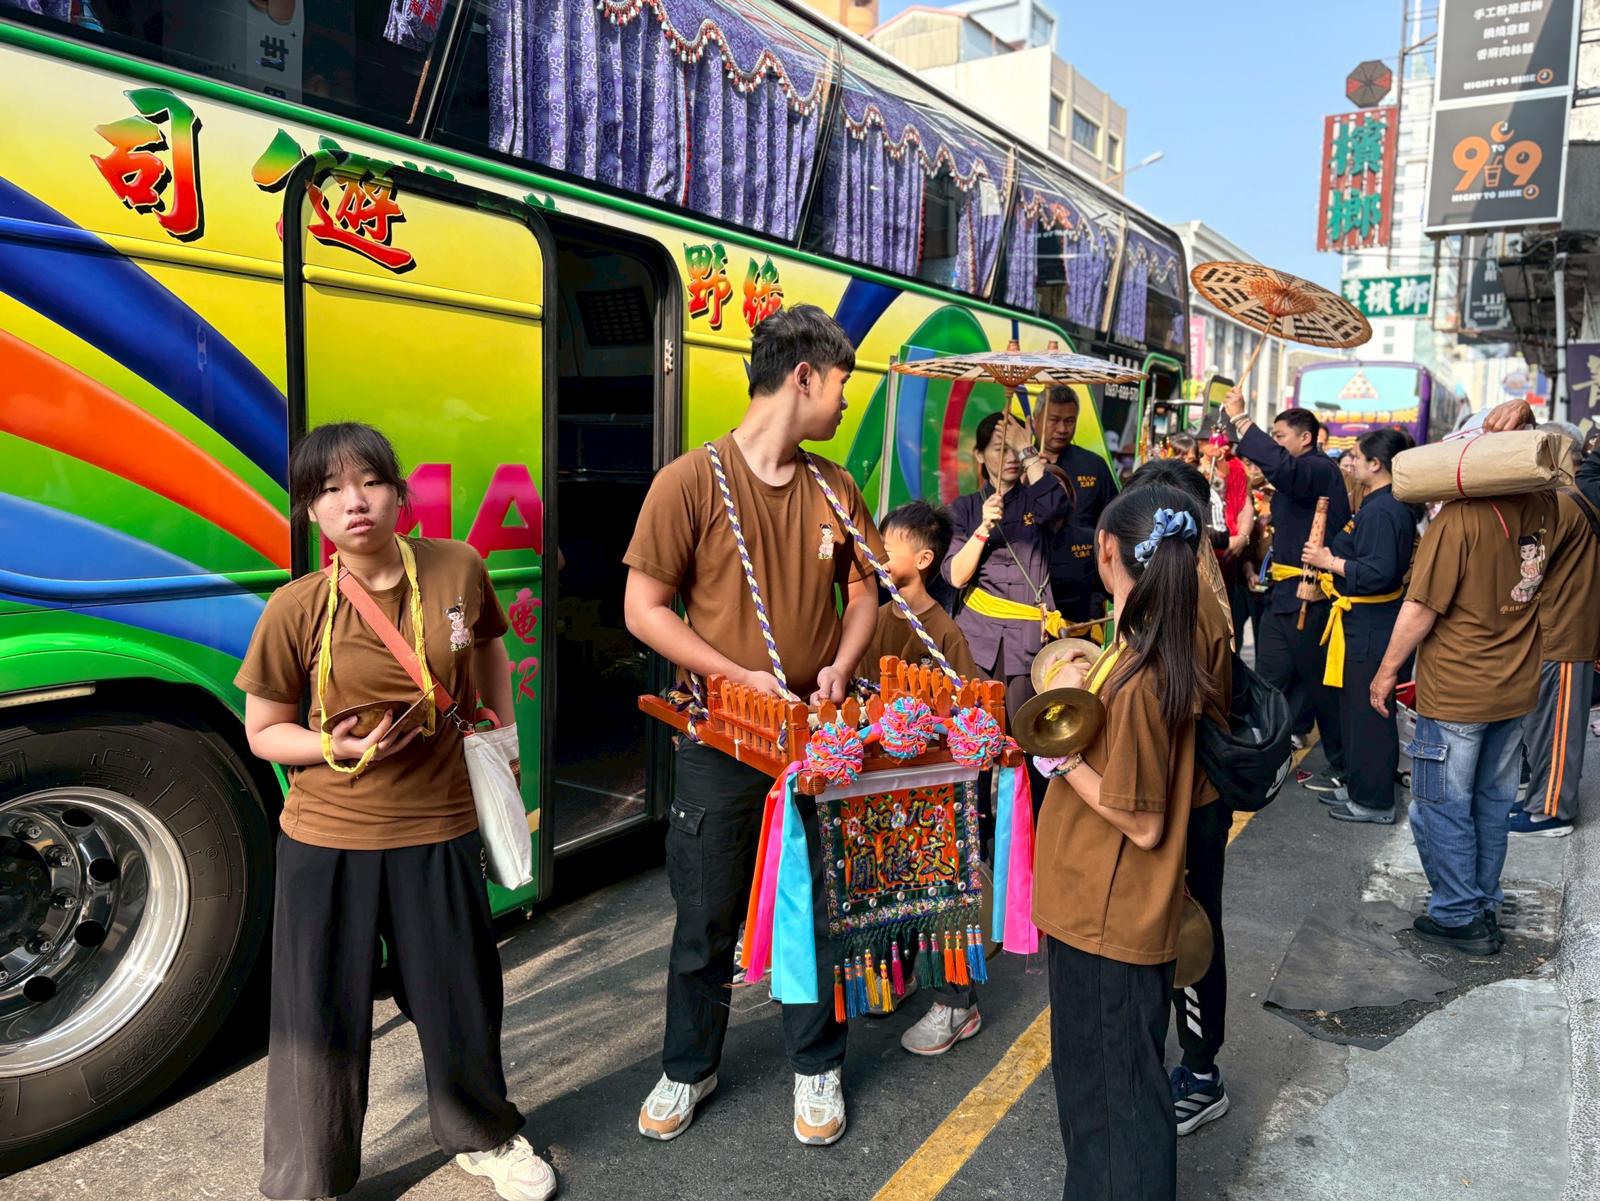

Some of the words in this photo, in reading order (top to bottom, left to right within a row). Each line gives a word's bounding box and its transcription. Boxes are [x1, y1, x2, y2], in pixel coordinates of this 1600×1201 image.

[1463, 79, 1495, 90] NIGHT
[1496, 77, 1509, 86] TO
[1511, 73, 1536, 84] NINE
[1328, 117, 1388, 242] 檳榔
[1452, 135, 1490, 192] 9
[1491, 144, 1505, 152] TO
[1503, 140, 1542, 186] 9
[1451, 192, 1482, 202] NIGHT
[1483, 191, 1496, 200] TO
[1498, 189, 1522, 198] NINE
